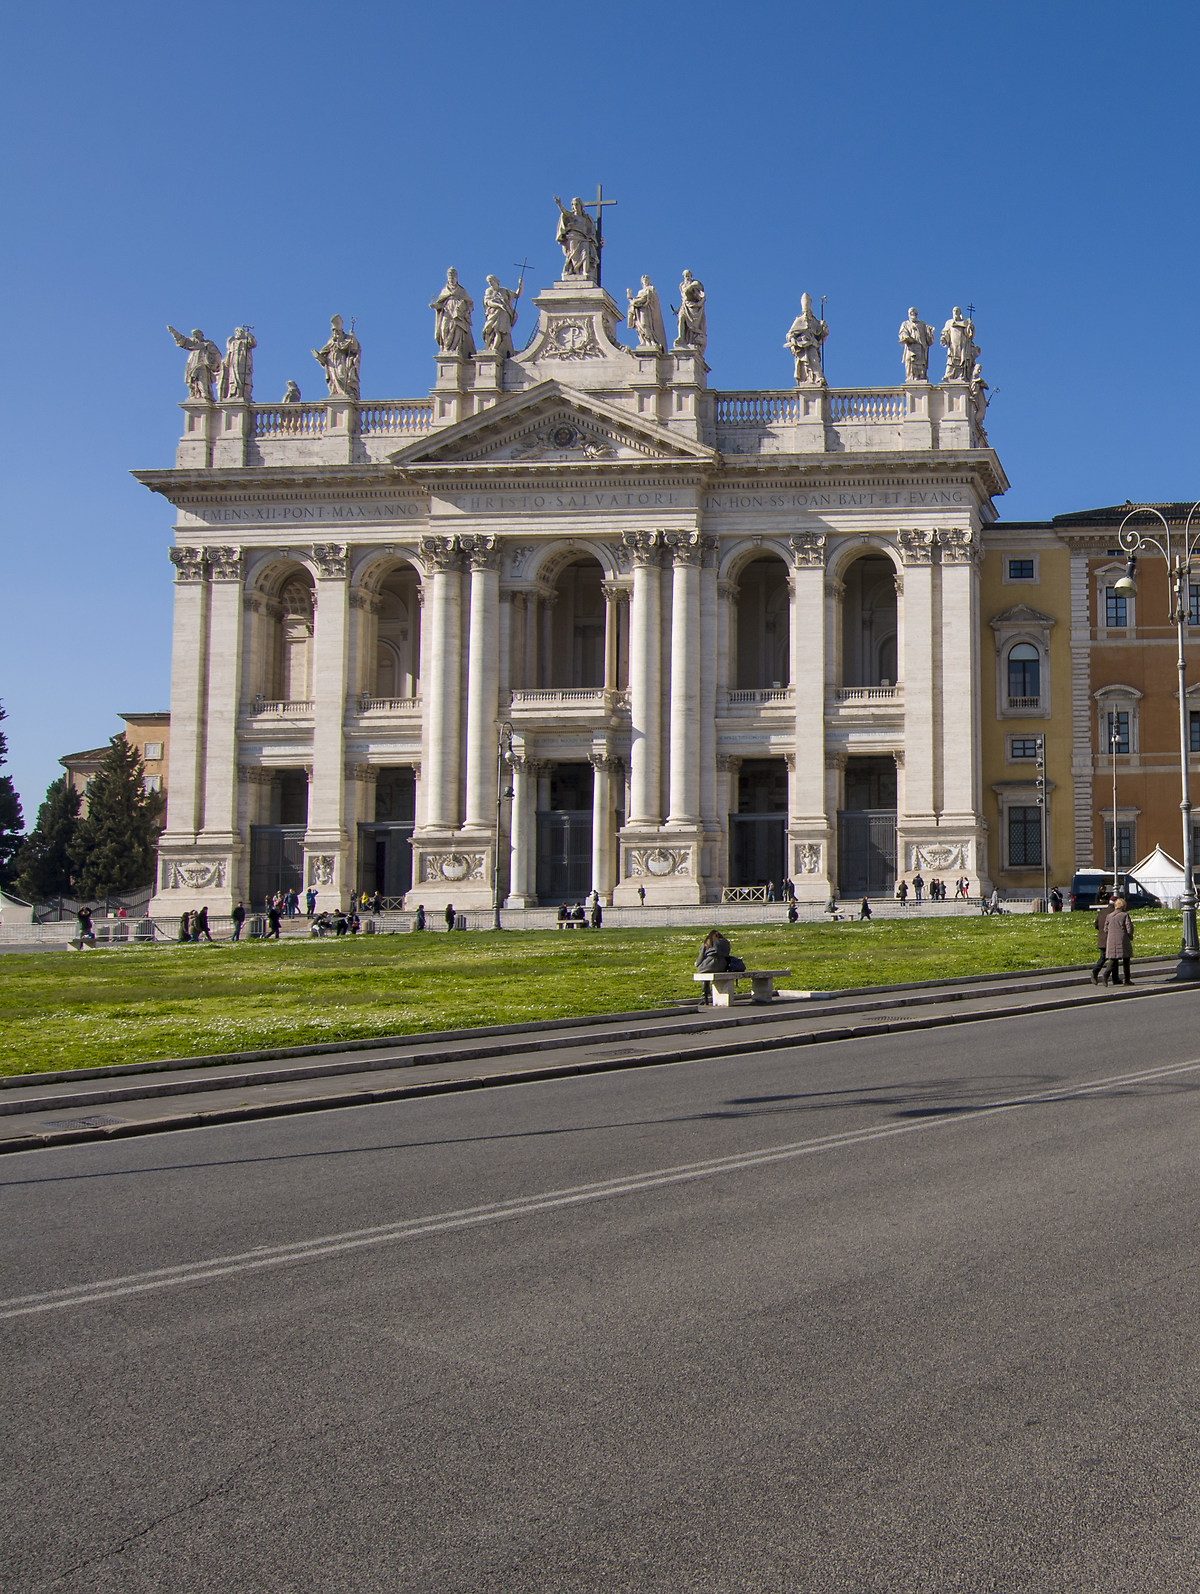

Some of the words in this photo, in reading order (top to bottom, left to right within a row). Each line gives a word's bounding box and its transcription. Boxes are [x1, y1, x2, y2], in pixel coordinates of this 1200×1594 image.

[455, 496, 545, 509] CHRISTO
[556, 493, 673, 507] SALVATORI
[706, 497, 721, 508] IN
[730, 495, 762, 508] HON
[770, 495, 785, 507] SS
[792, 494, 831, 506] IOAN
[839, 493, 876, 505] BAPT
[884, 493, 900, 504] ET
[910, 491, 962, 503] EVANG
[184, 508, 249, 521] CLEMENS
[255, 508, 276, 519] XII
[284, 506, 325, 518] PONT
[332, 505, 366, 517] MAX
[374, 504, 418, 515] ANNO
